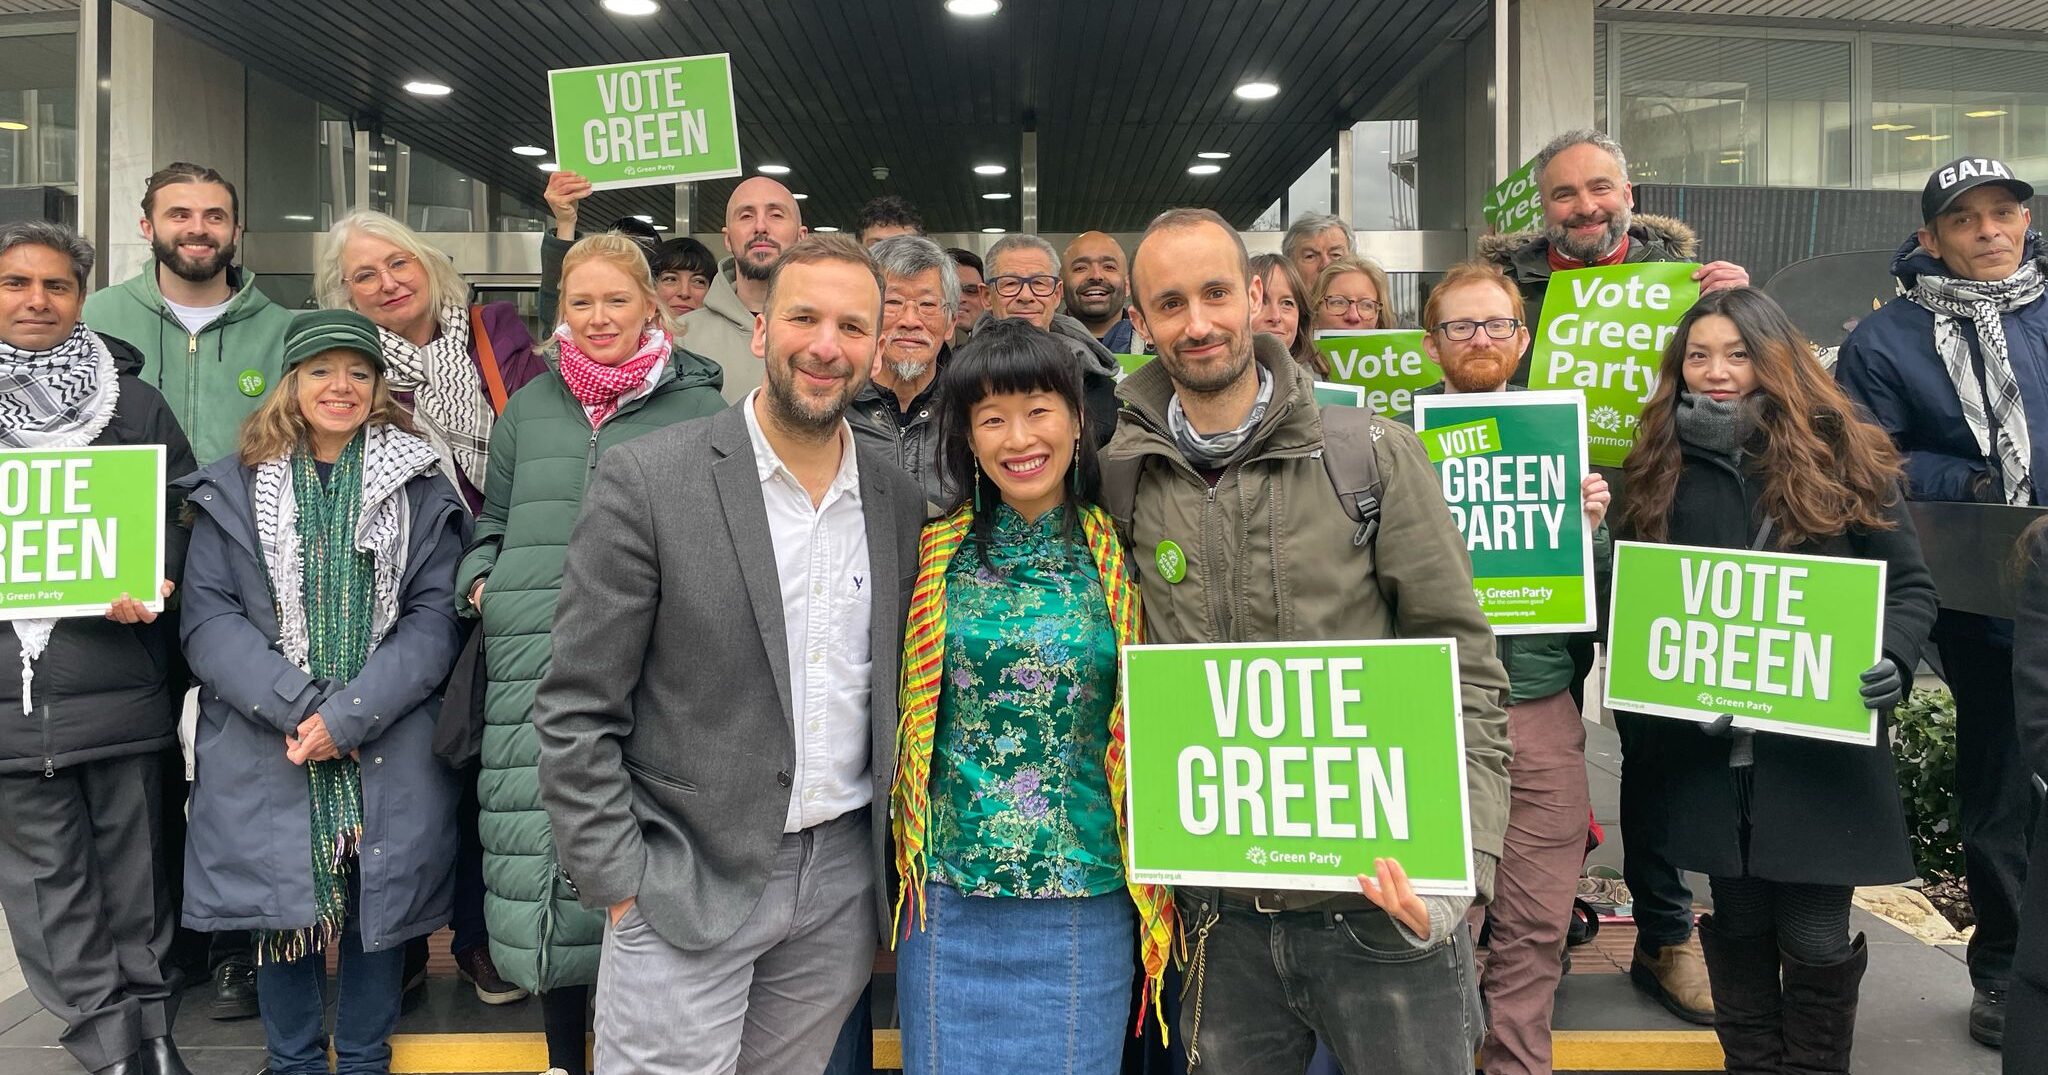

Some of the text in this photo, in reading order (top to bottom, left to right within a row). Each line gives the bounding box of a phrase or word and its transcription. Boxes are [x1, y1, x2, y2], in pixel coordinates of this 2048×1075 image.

[596, 66, 686, 114] VOTE
[583, 108, 709, 165] GREEN
[636, 163, 676, 173] Green Party
[1495, 167, 1537, 208] Vot
[1938, 158, 2011, 190] GAZA
[1495, 190, 1542, 233] Gree
[1571, 274, 1672, 311] Vote
[1329, 345, 1423, 381] Vote
[1546, 350, 1661, 404] Party
[1437, 424, 1491, 457] VOTE
[1587, 435, 1634, 448] ommon
[0, 458, 93, 517] OTE
[1441, 453, 1566, 503] GREEN
[0, 517, 118, 584] EEN
[6, 591, 64, 602] Green Party
[1486, 586, 1553, 601] Green Party
[1680, 557, 1809, 627] VOTE
[1647, 616, 1833, 702] GREEN
[1204, 657, 1368, 739] VOTE
[1715, 696, 1773, 714] Green Party
[1177, 744, 1410, 841] GREEN
[1269, 850, 1342, 868] Green Party
